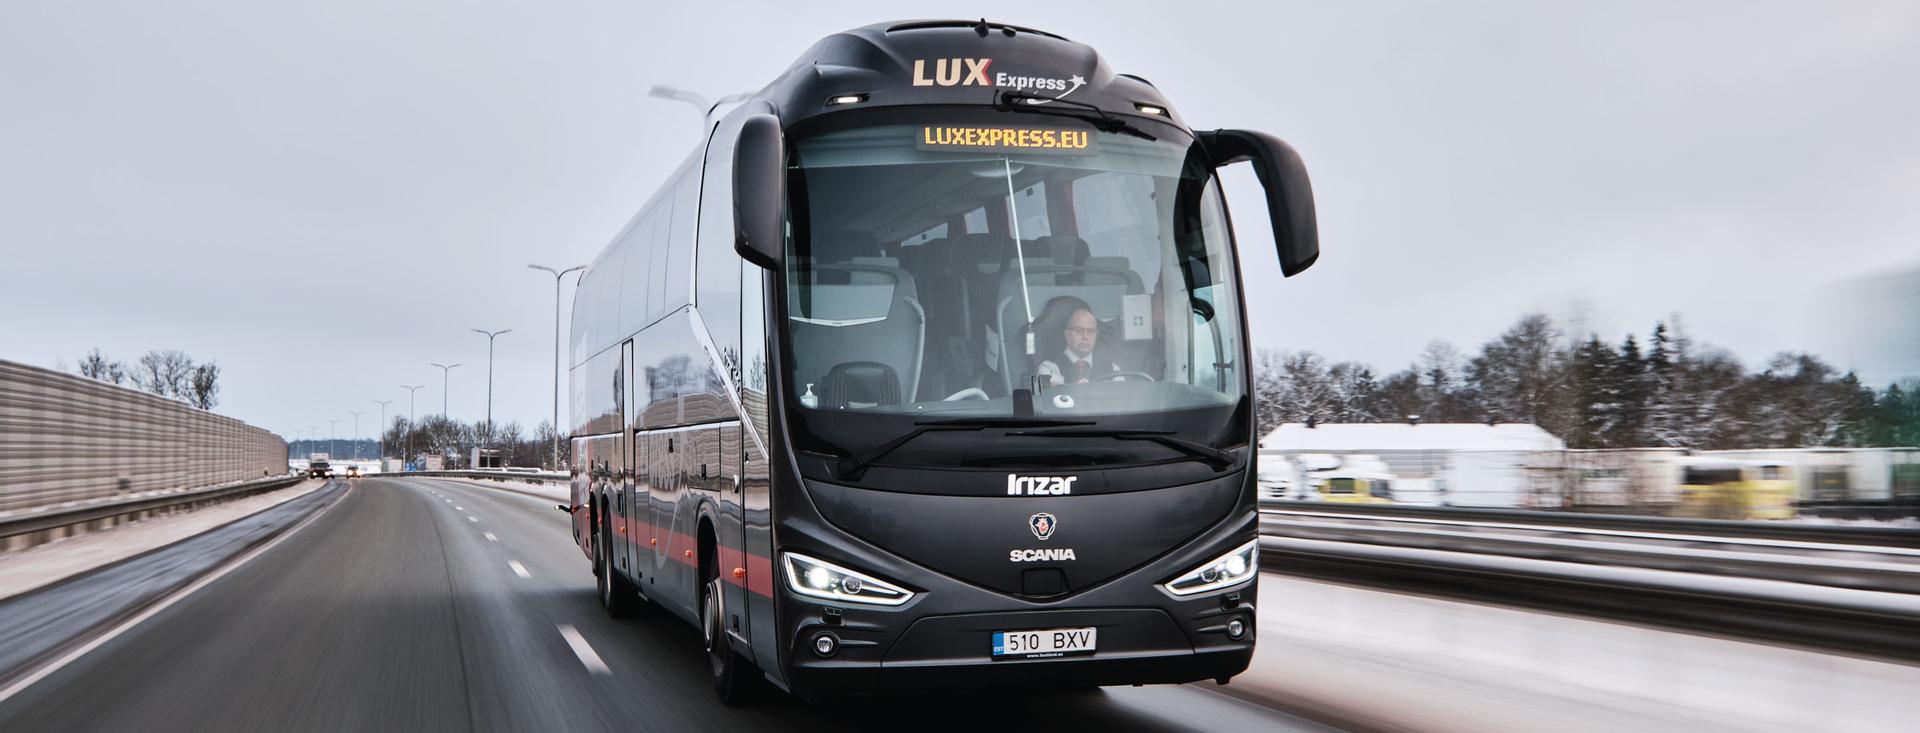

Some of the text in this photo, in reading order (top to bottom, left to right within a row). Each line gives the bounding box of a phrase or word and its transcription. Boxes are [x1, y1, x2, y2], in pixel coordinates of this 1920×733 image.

[912, 58, 1066, 91] LUX Express
[924, 126, 1088, 148] LUXEXPRESS.EU
[1008, 474, 1077, 495] Irizar
[1010, 549, 1076, 562] SCANIA
[1009, 631, 1090, 651] 510 BXV
